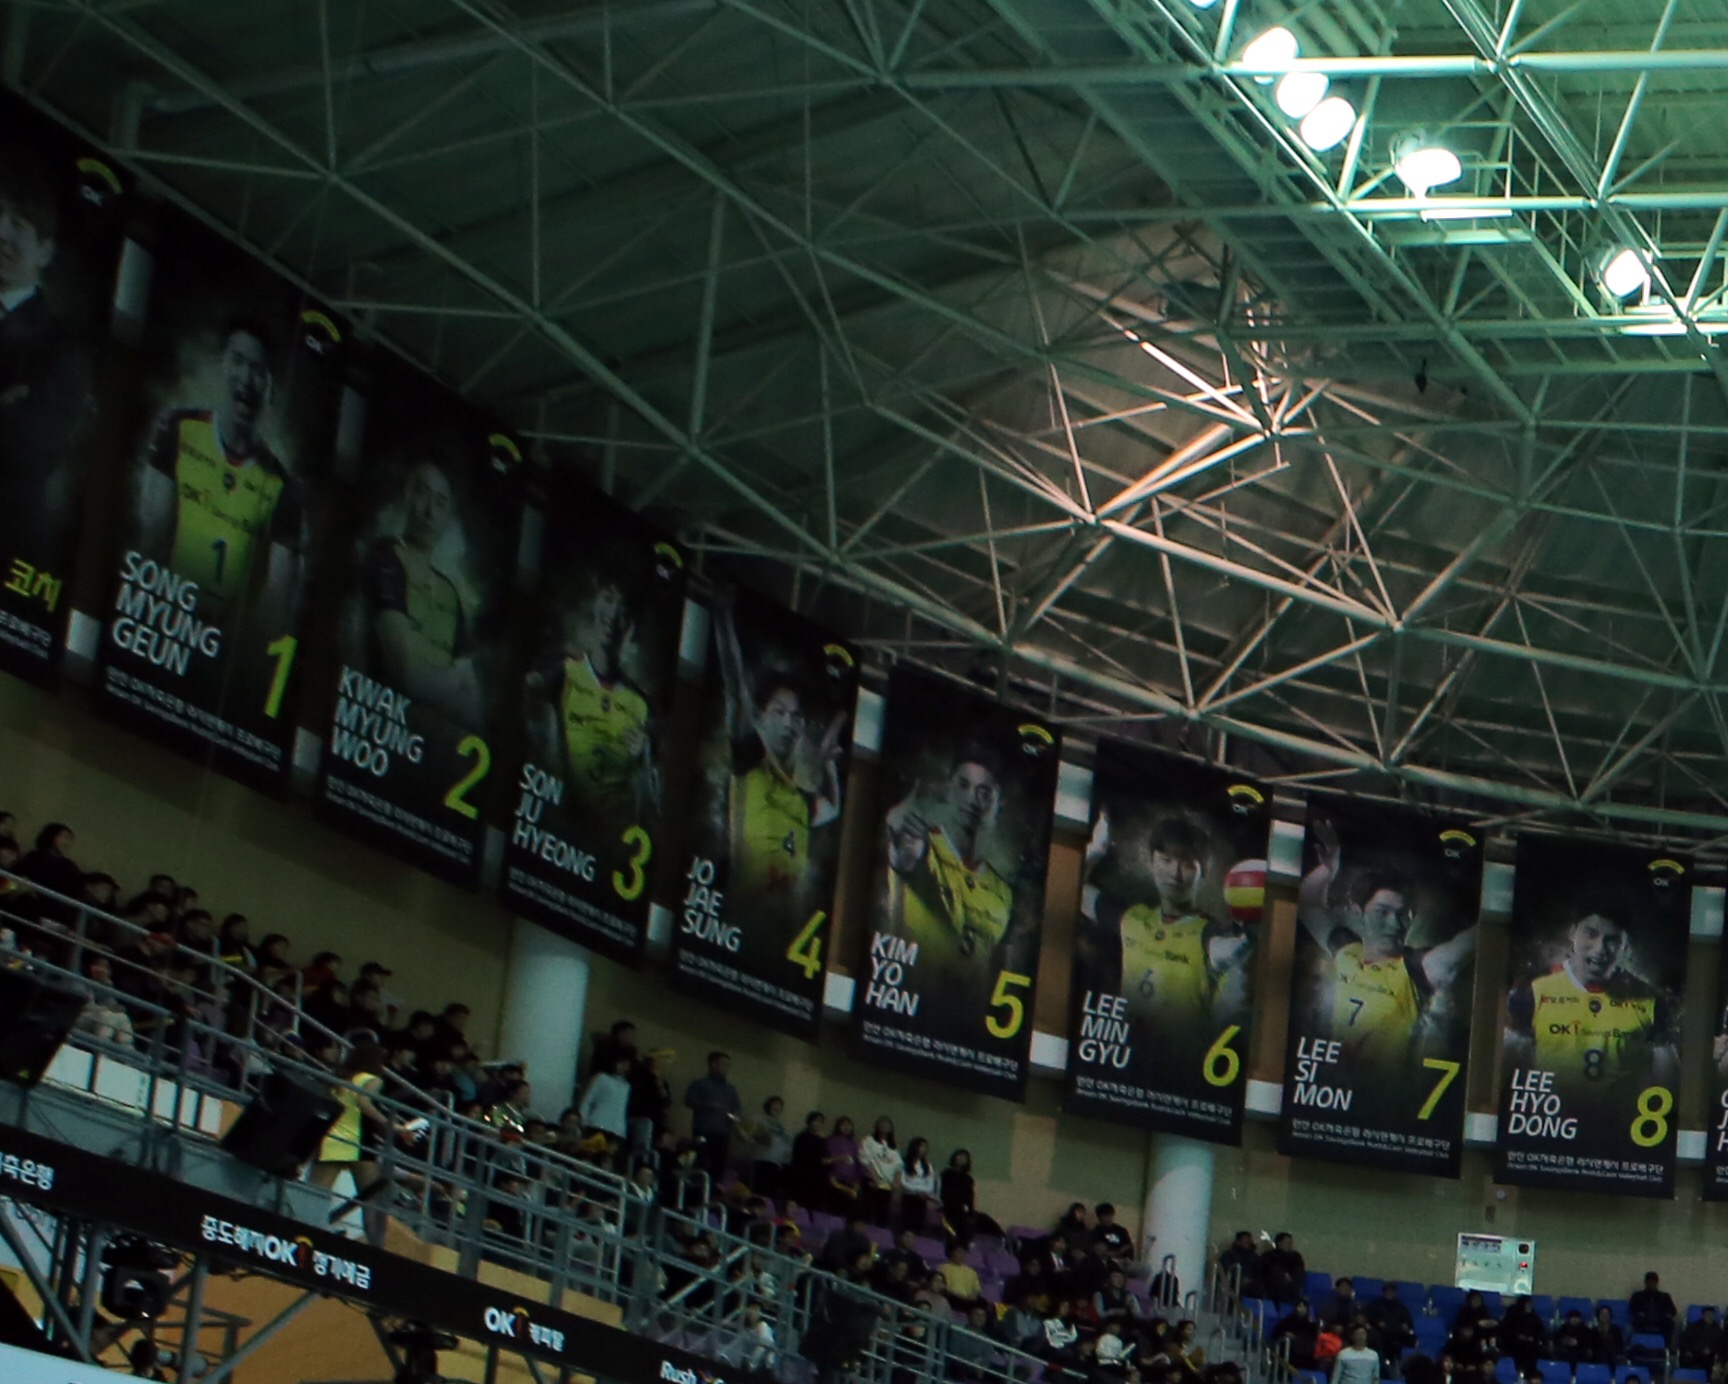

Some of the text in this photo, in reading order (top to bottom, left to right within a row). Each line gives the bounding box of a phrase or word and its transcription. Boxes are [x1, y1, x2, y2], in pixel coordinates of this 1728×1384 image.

[119, 550, 199, 613] SONG
[116, 587, 222, 658] MYUNG
[111, 620, 191, 676] GEUN
[264, 634, 298, 718] 1
[338, 665, 412, 722] KWAK
[330, 727, 390, 777] WOO
[335, 698, 424, 763] MYUNG
[444, 735, 491, 820] 2
[518, 763, 564, 806] SON
[515, 794, 544, 824] JU
[512, 823, 596, 883] HYEONG
[612, 825, 654, 900] 3
[686, 856, 716, 886] JO
[683, 885, 723, 917] JAE
[681, 910, 743, 953] SUNG
[786, 909, 827, 980] 4
[870, 931, 919, 966] KIM
[869, 960, 901, 987] YO
[865, 983, 919, 1017] HAN
[985, 970, 1032, 1039] 5
[1083, 990, 1128, 1020] LEE
[1081, 1015, 1130, 1043] MIN
[1296, 1036, 1341, 1064] LEE
[1079, 1039, 1131, 1070] GYU
[1202, 1025, 1241, 1087] 6
[1294, 1060, 1321, 1084] SI
[1292, 1083, 1352, 1112] MON
[1417, 1058, 1461, 1120] 7
[1510, 1068, 1554, 1093] LEE
[1510, 1092, 1561, 1117] HYO
[1630, 1086, 1674, 1147] 8
[1508, 1114, 1578, 1140] DONG
